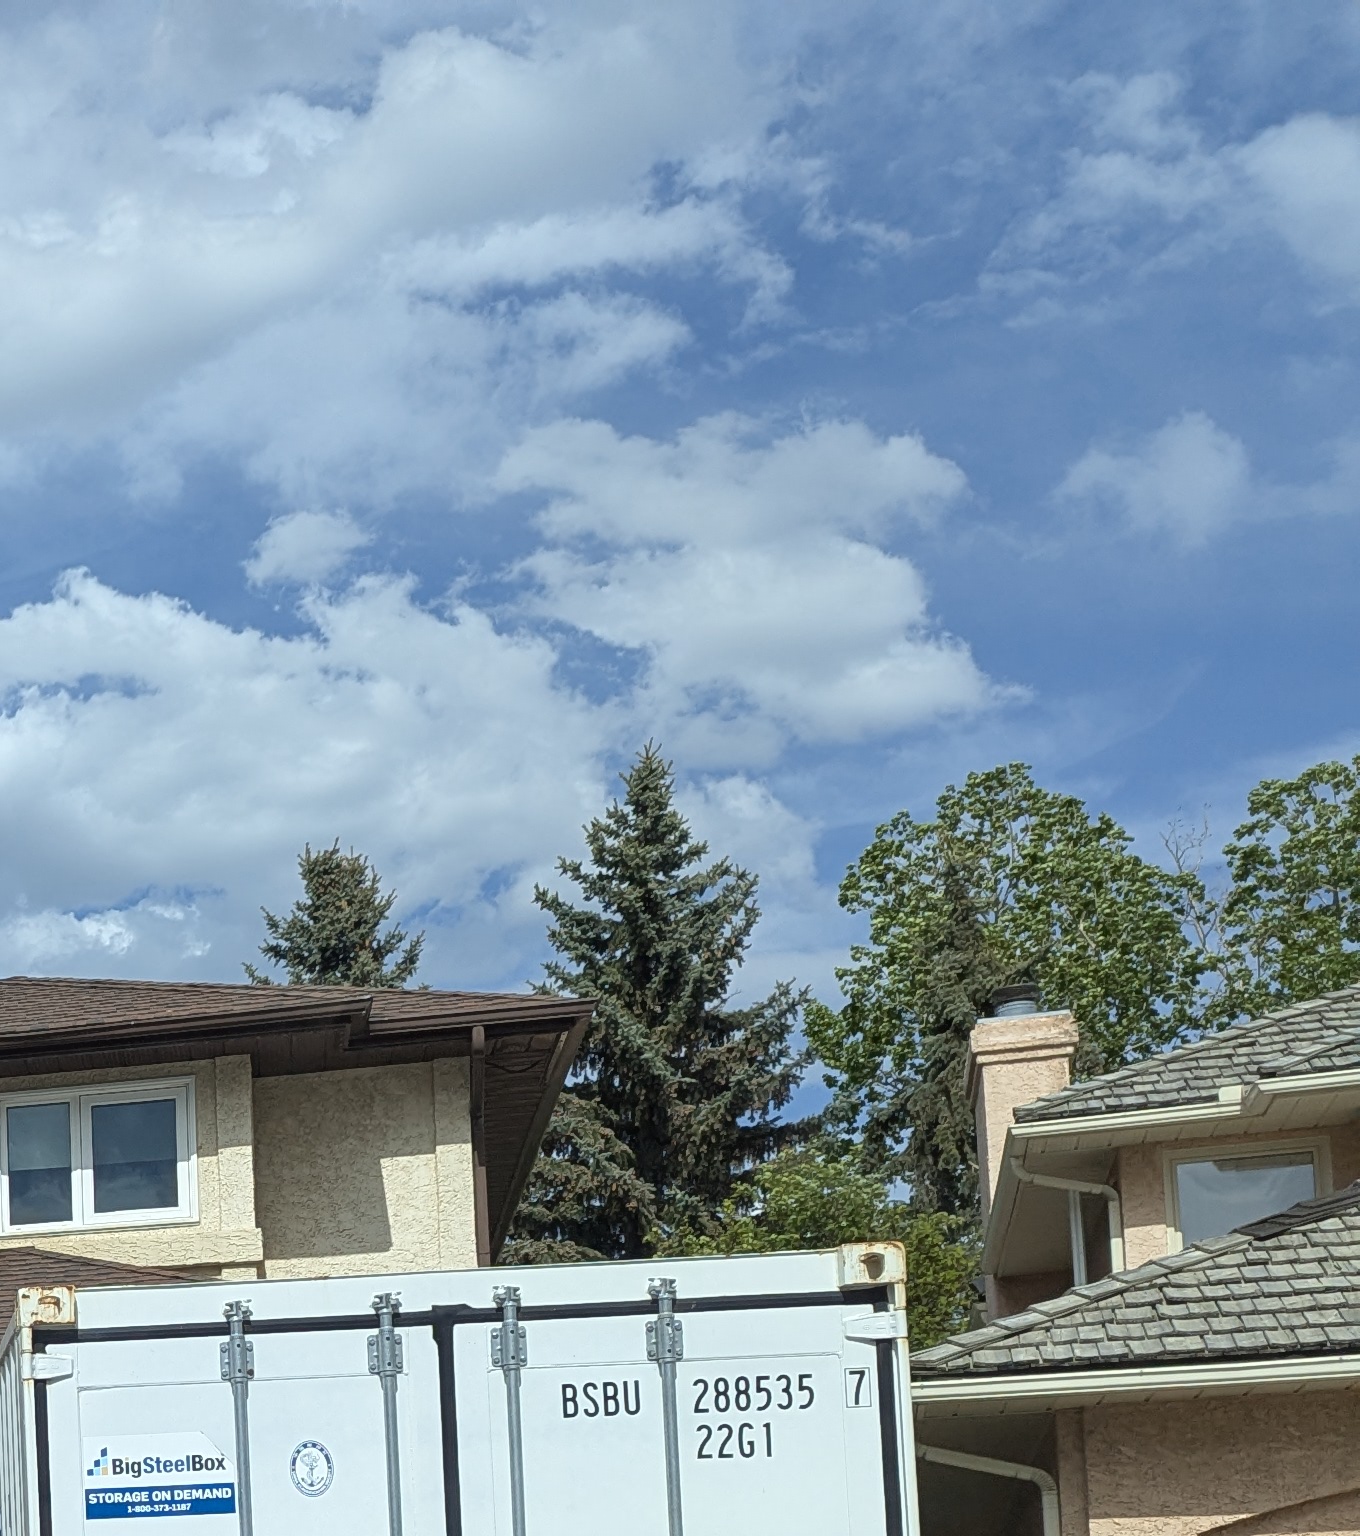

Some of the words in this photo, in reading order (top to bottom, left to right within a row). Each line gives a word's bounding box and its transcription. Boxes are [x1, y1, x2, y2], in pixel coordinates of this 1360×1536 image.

[561, 1380, 641, 1419] BSBU
[692, 1373, 815, 1414] 288535
[848, 1370, 867, 1406] 7
[696, 1422, 773, 1459] 22G1
[111, 1454, 226, 1479] BigSteelBox
[88, 1490, 150, 1505] STORAGE
[152, 1489, 172, 1502] ON
[174, 1487, 232, 1501] DEMAND
[127, 1502, 192, 1514] 1-800-373-1187
